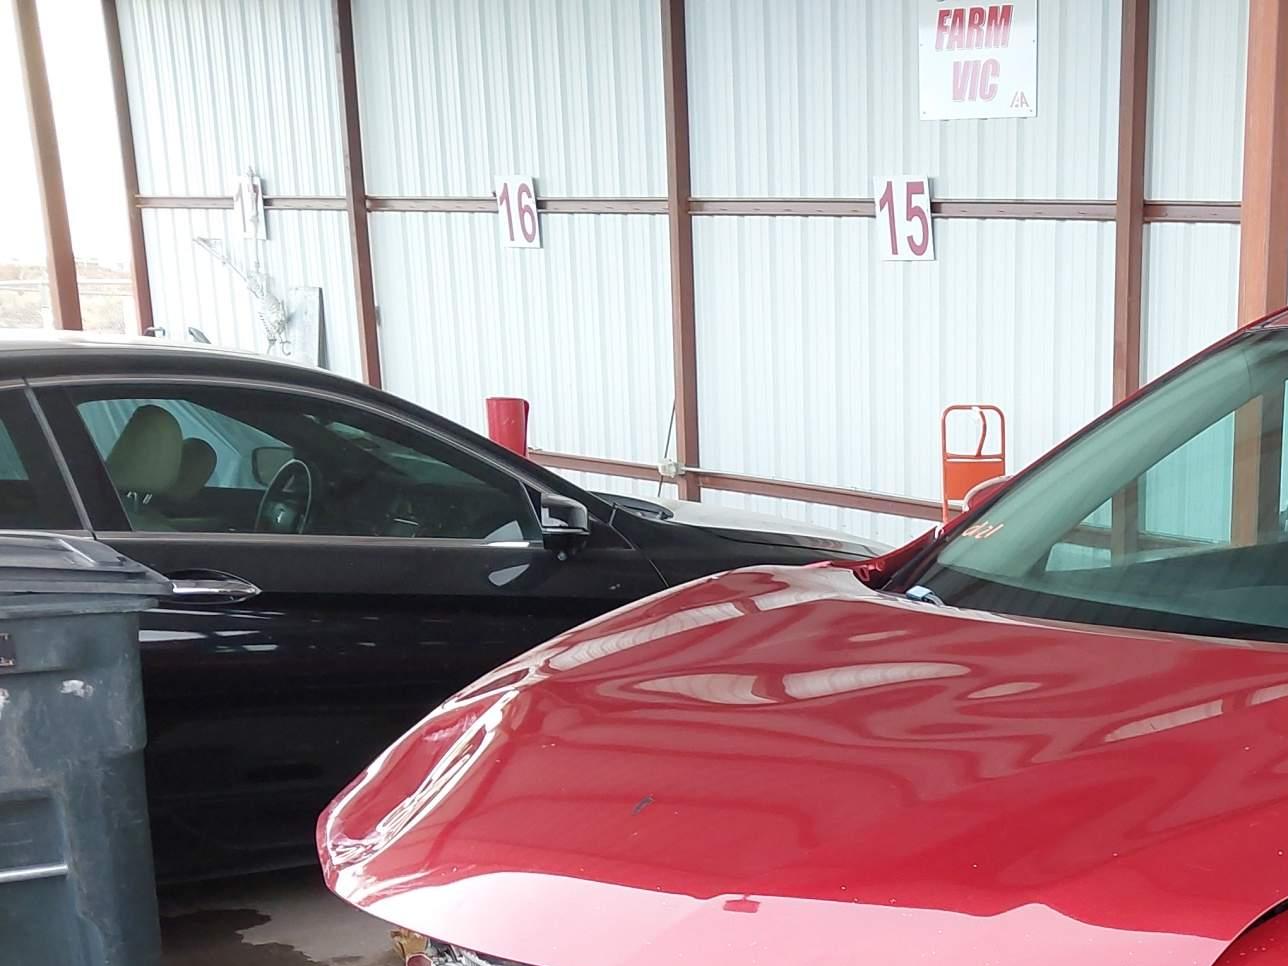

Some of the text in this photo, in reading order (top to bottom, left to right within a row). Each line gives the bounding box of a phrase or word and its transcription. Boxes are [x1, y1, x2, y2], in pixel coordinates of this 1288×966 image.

[935, 4, 1013, 51] FARM
[952, 58, 1000, 102] VIC
[499, 182, 537, 243] 16
[879, 181, 929, 256] 15
